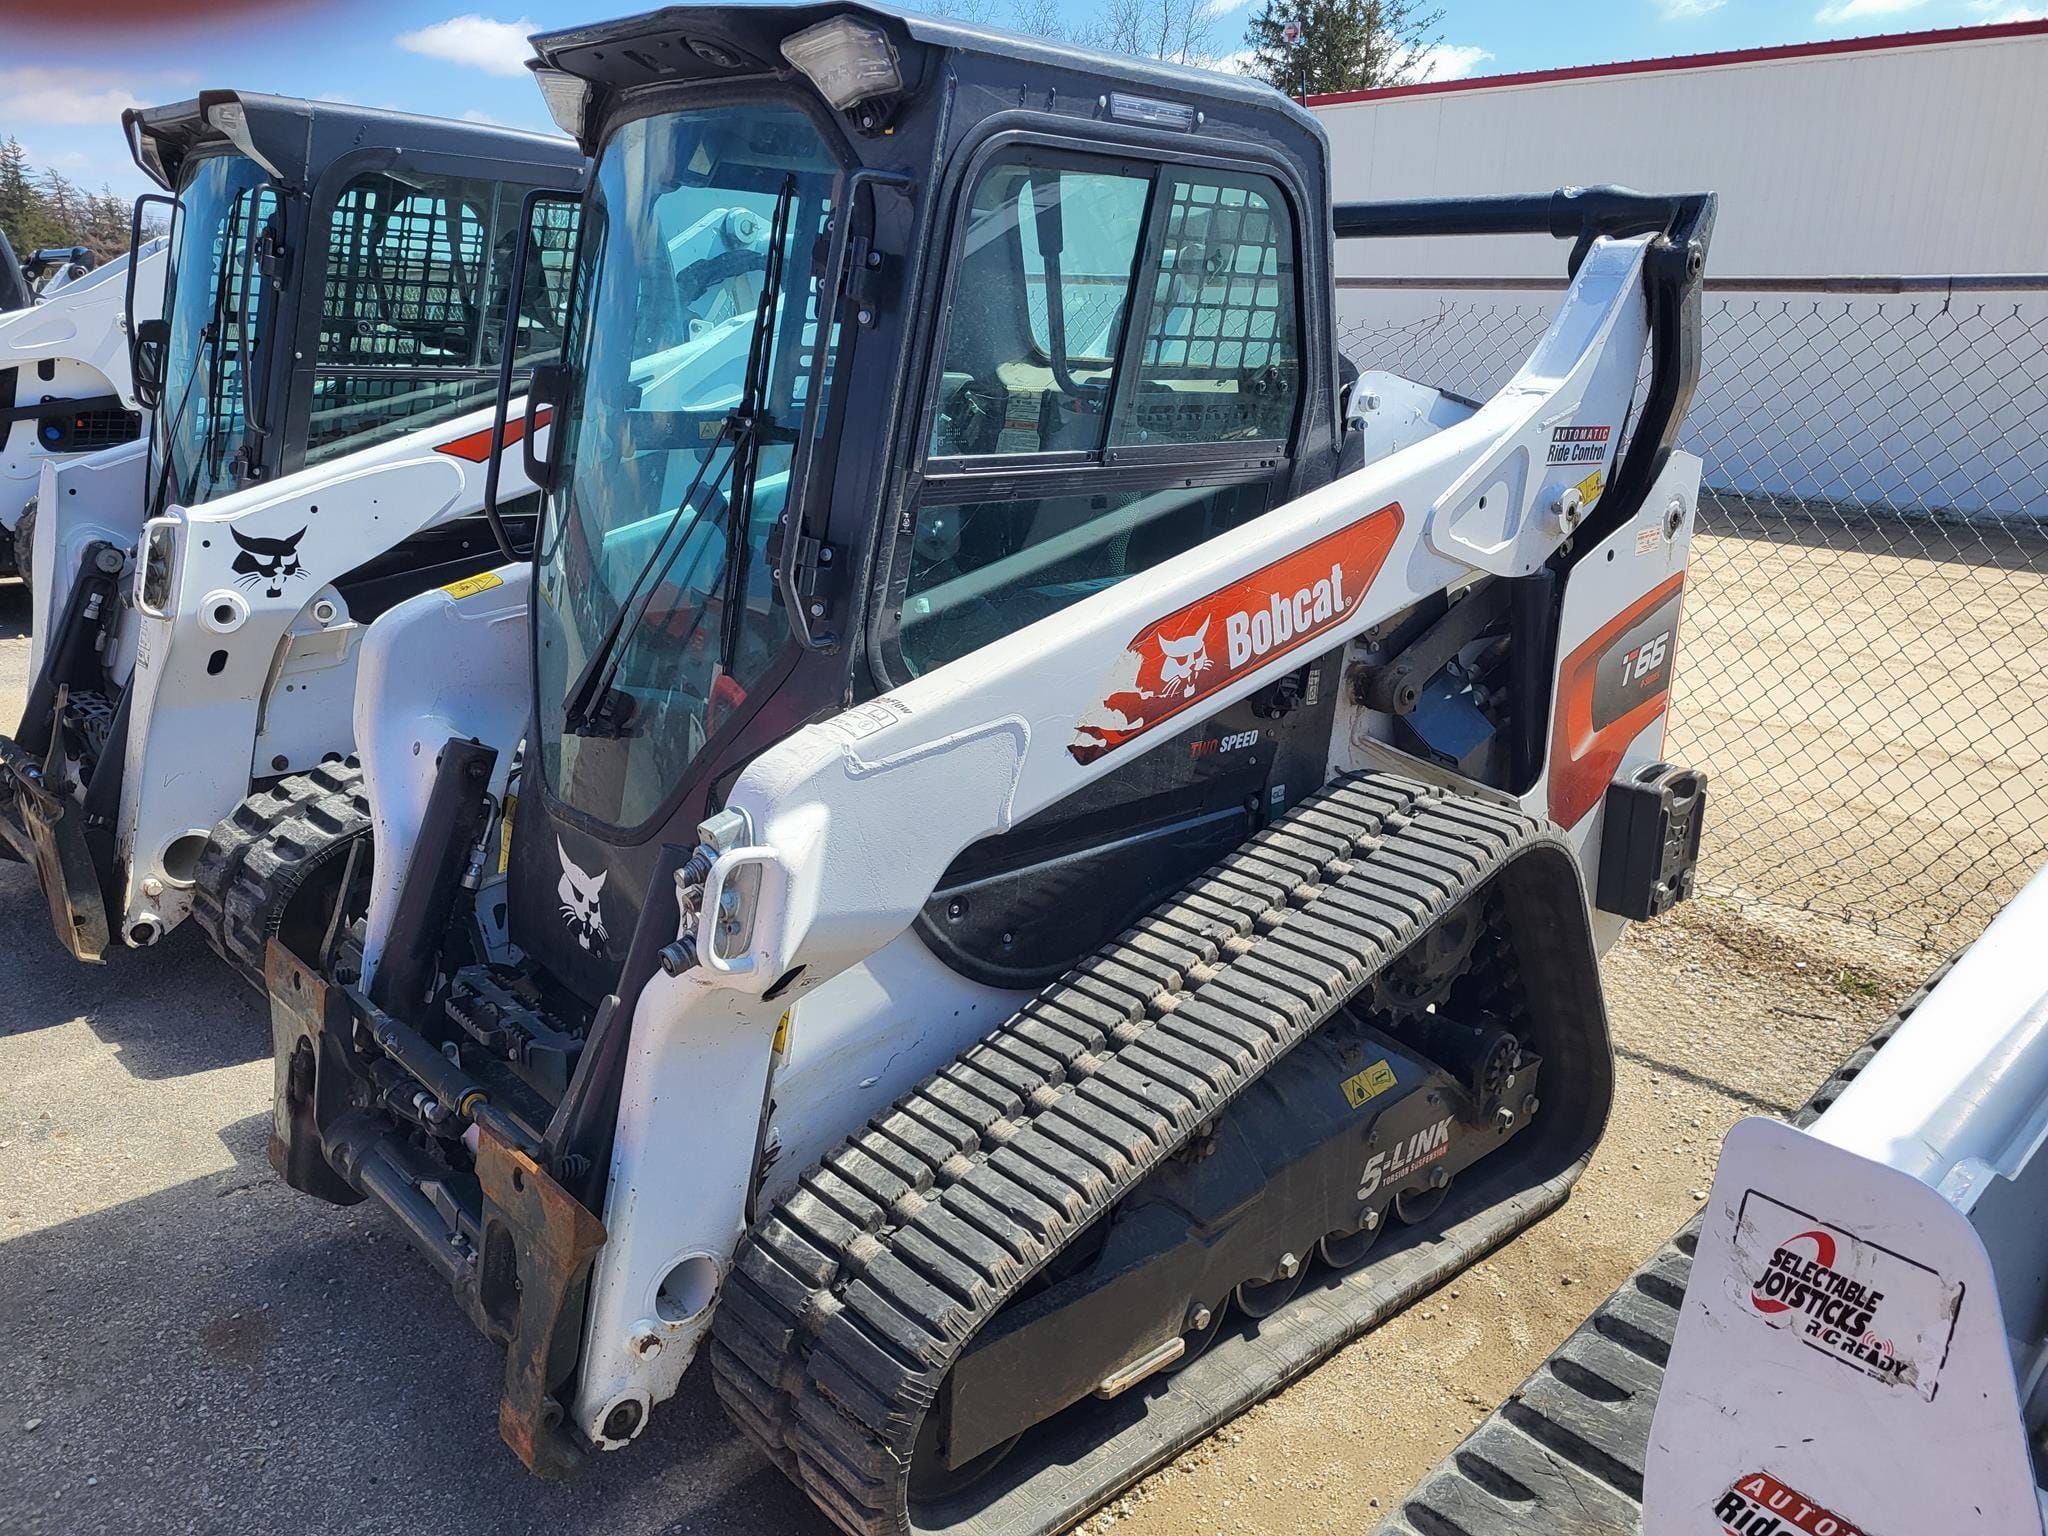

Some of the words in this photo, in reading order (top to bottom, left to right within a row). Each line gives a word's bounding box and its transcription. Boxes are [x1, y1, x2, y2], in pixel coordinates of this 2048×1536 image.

[1547, 444, 1570, 462] Ride
[1571, 443, 1607, 461] Control
[1554, 427, 1609, 441] AUTOMATIC
[1226, 563, 1344, 670] Bobcat
[1622, 631, 1670, 687] T66
[1190, 738, 1219, 758] TWO
[1219, 729, 1259, 753] SPEED
[1356, 1113, 1456, 1201] 5-LINK
[1382, 1166, 1410, 1188] TORSION
[1410, 1143, 1449, 1172] SUSPENSION
[1753, 1267, 1873, 1338] JOYSTICKS
[1768, 1247, 1885, 1314] SELECTABLE
[1805, 1319, 1842, 1346] R/C
[1840, 1336, 1909, 1378] READY
[1743, 1477, 1858, 1536] AUTO
